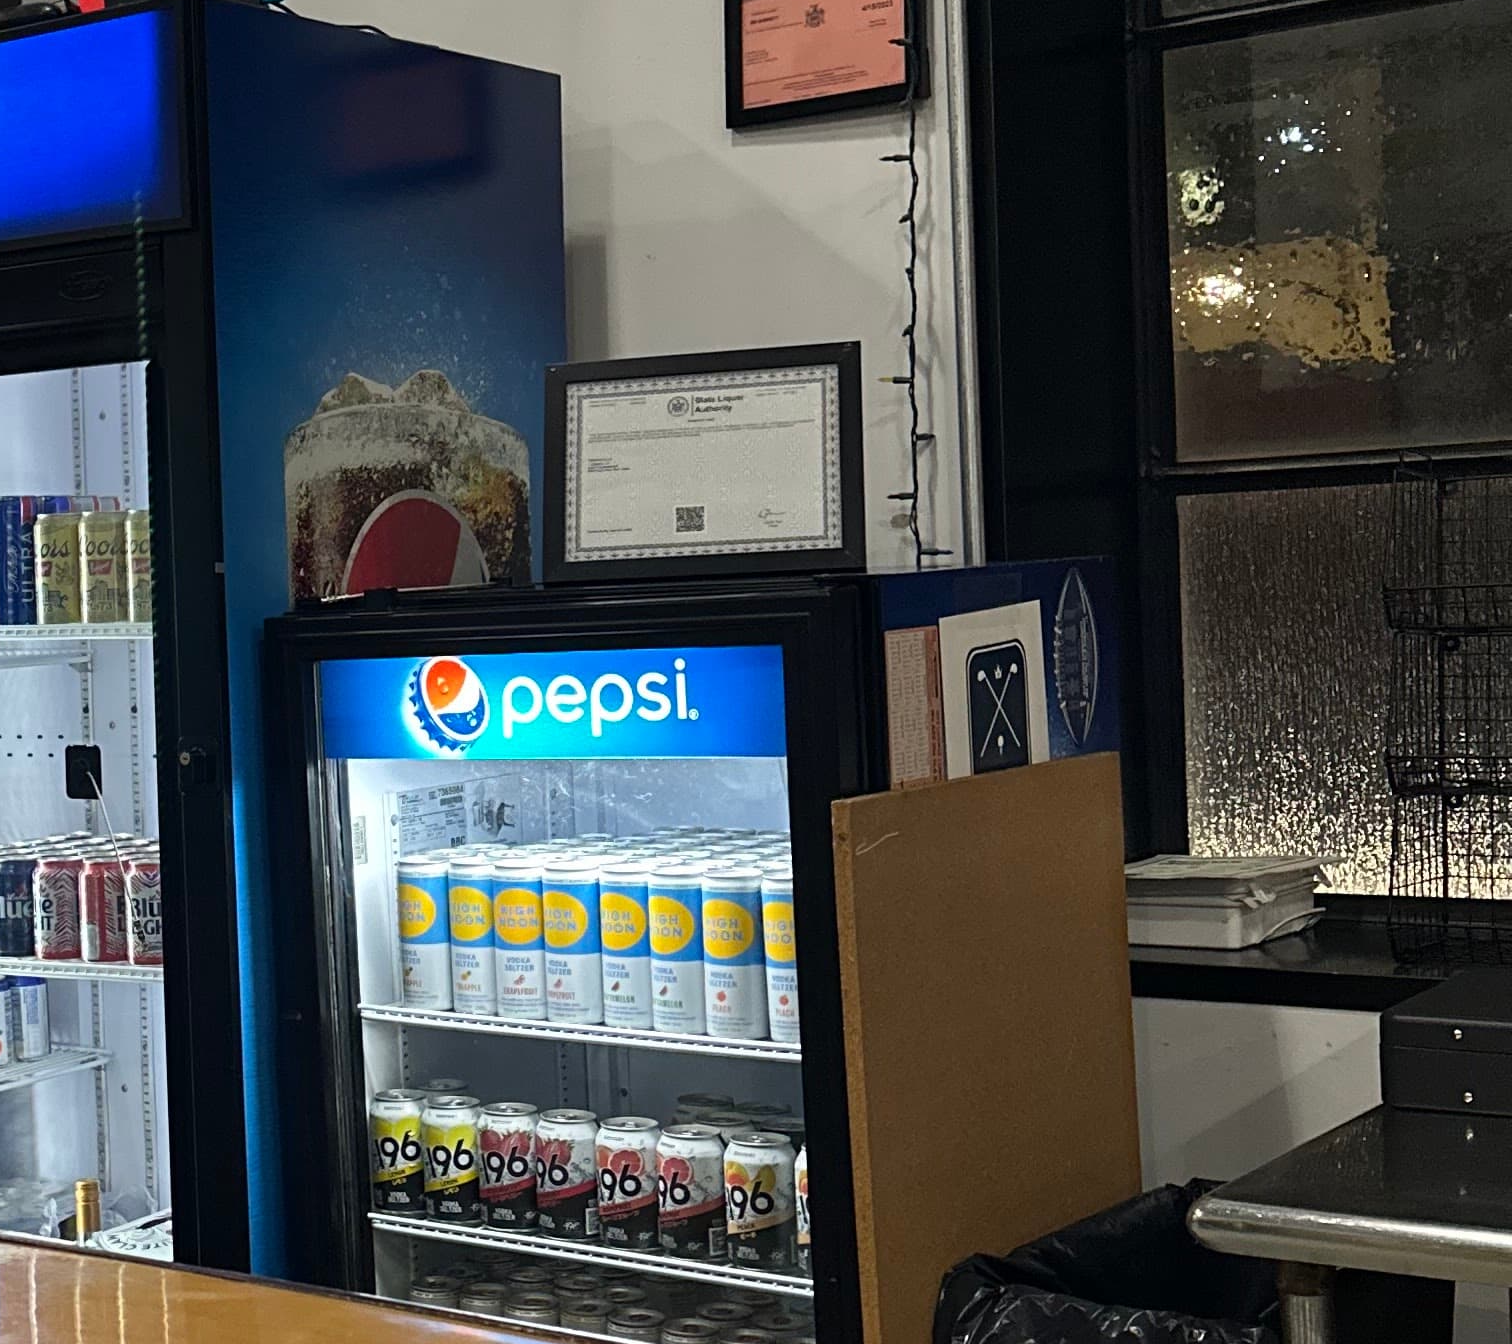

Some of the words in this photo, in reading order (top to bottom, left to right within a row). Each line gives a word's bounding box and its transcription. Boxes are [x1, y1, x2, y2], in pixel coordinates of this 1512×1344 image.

[21, 531, 34, 603] ULTRA
[501, 657, 688, 739] pepsi
[498, 917, 540, 928] NOON
[500, 904, 537, 916] HIGH
[375, 1129, 422, 1170] 196
[426, 1138, 474, 1178] 196
[481, 1146, 529, 1185] 196
[537, 1153, 569, 1189] 96
[658, 1171, 691, 1209] 96
